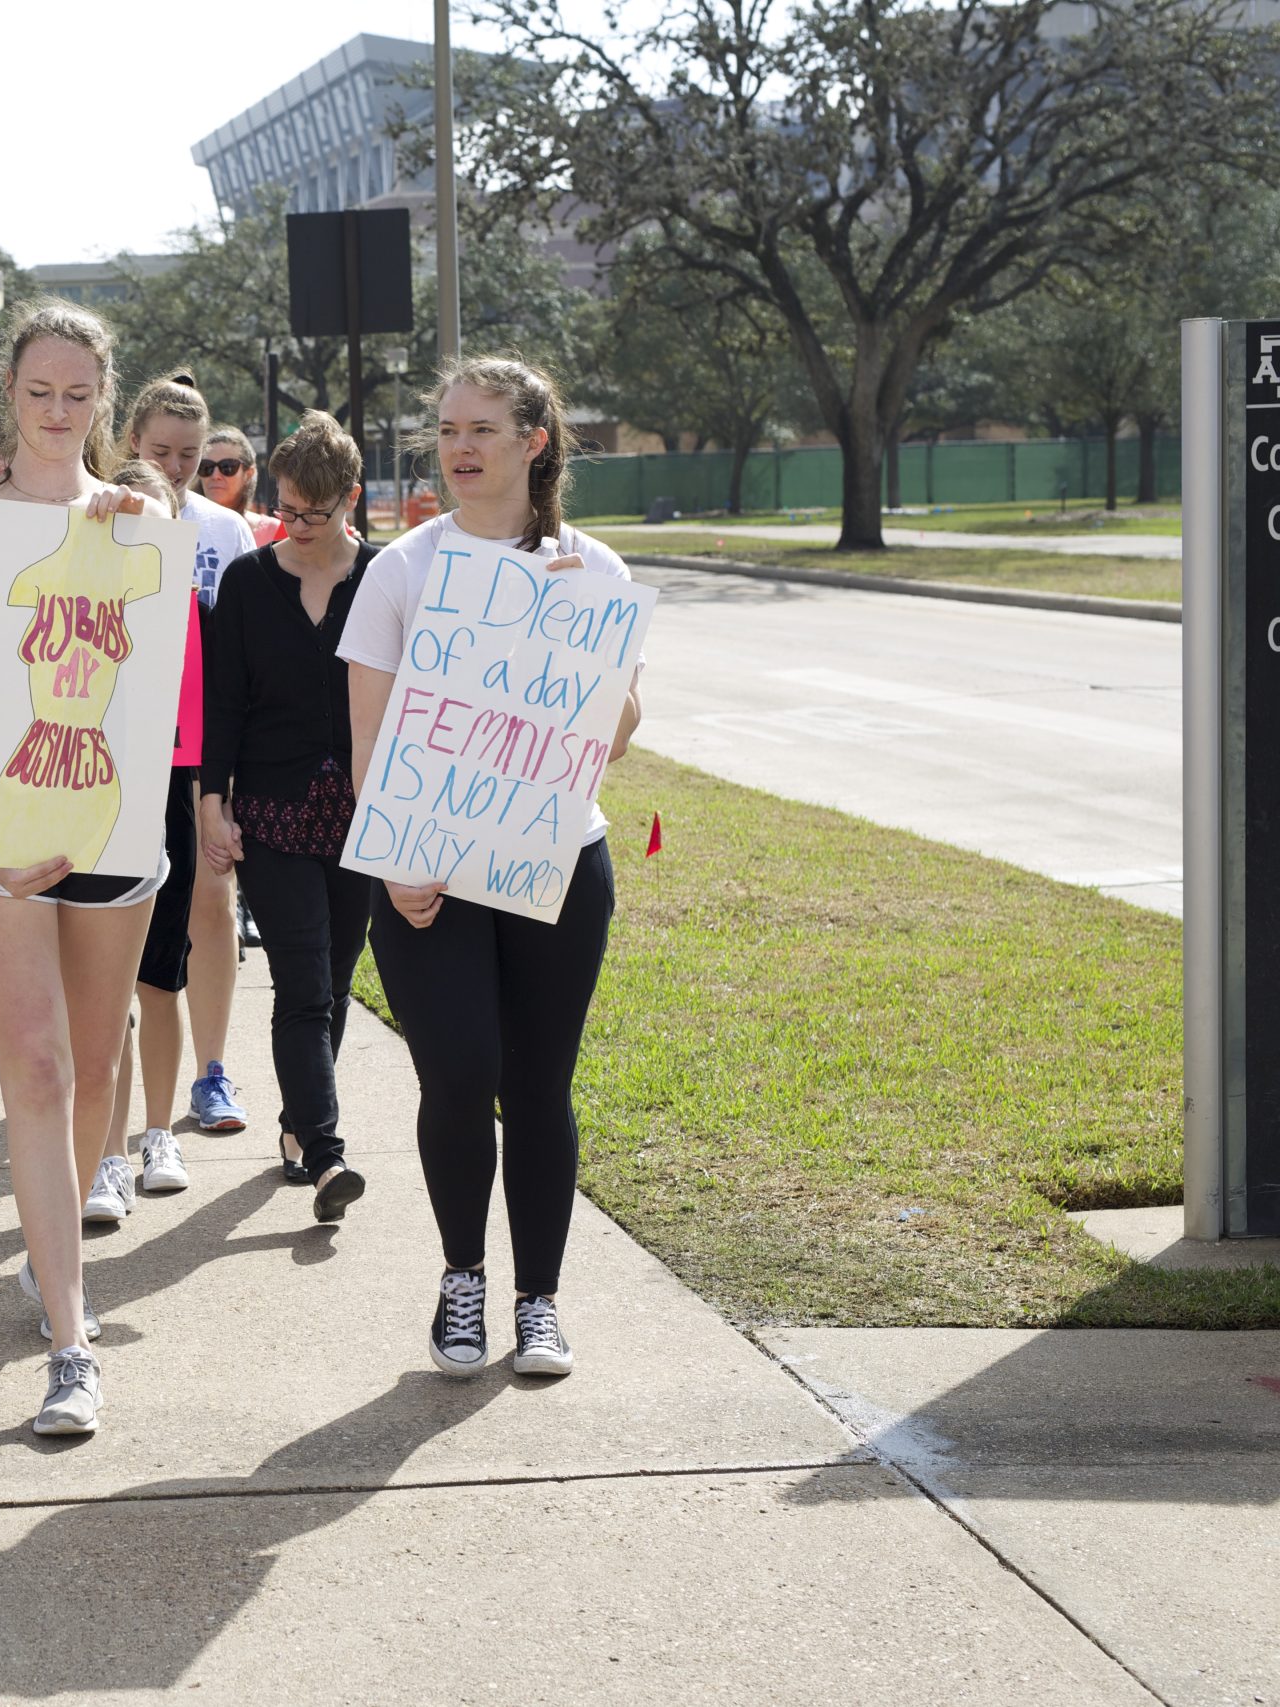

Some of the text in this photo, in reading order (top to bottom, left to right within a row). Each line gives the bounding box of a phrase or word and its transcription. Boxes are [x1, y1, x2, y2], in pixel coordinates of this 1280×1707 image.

[424, 550, 472, 614] I
[52, 646, 101, 698] MY
[482, 659, 510, 694] a
[523, 650, 602, 731] day
[5, 718, 115, 790] BUSINESS
[395, 686, 609, 801] FEMINISM
[379, 735, 560, 845] IS NOT A
[354, 803, 564, 908] DIRTY WORD
